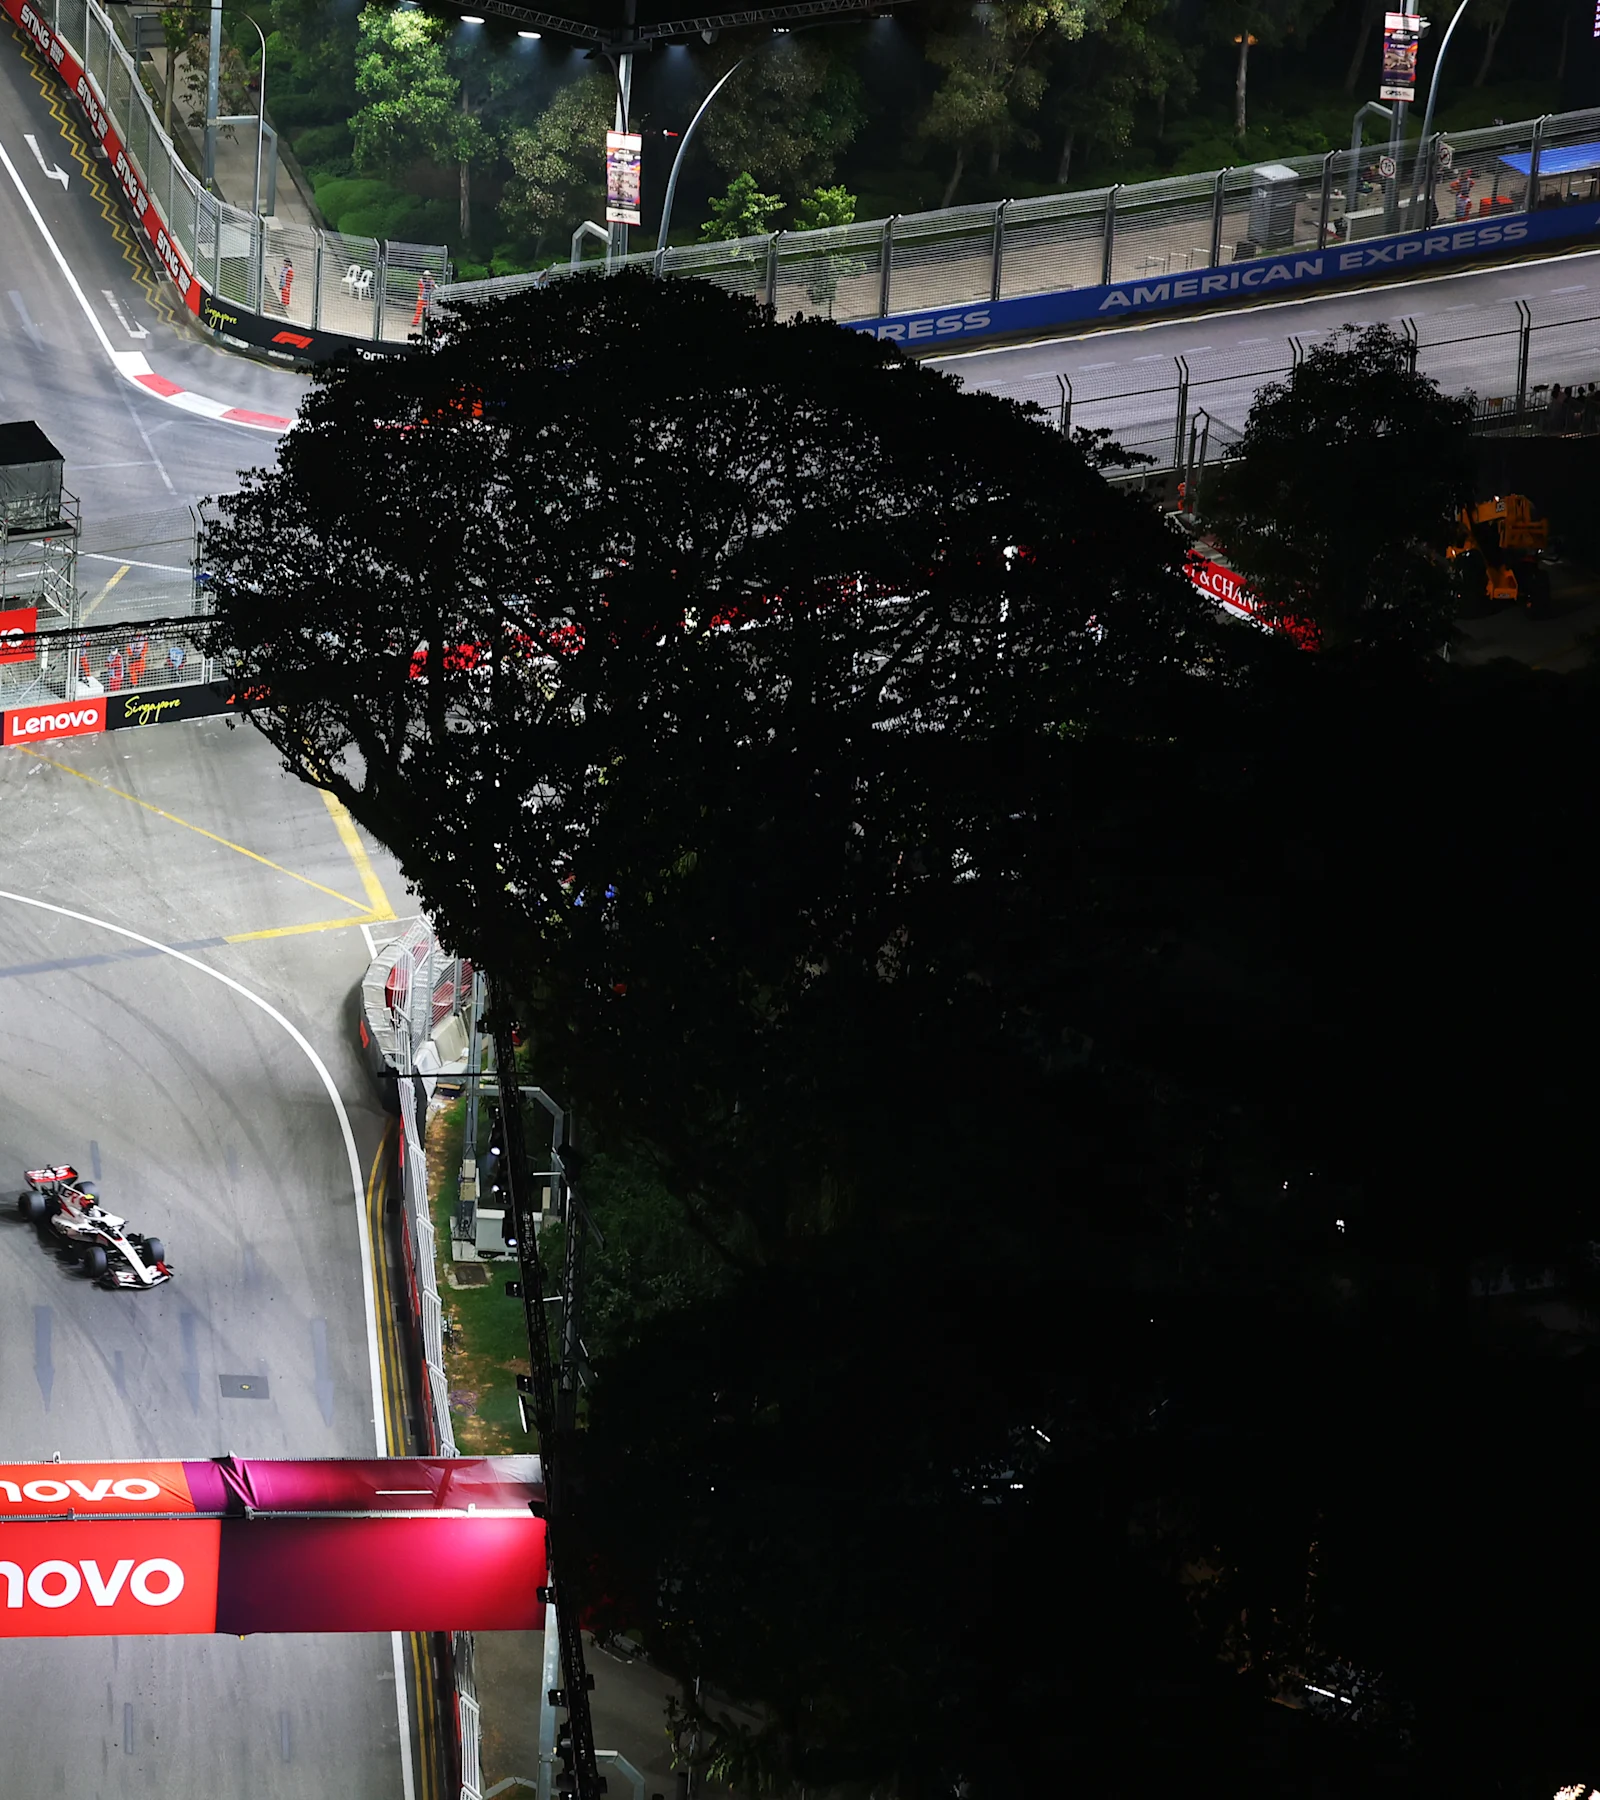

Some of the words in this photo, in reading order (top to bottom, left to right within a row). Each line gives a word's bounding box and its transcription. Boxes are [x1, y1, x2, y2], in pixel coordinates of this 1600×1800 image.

[20, 4, 50, 50] STING
[77, 76, 98, 122] STING
[116, 151, 138, 198] STING
[156, 229, 179, 277] STING
[1099, 257, 1324, 311] AMERICAN
[1339, 221, 1528, 271] EXPRESS
[204, 298, 238, 330] Singapore
[12, 709, 98, 736] Lenovo
[125, 695, 181, 725] Singapore
